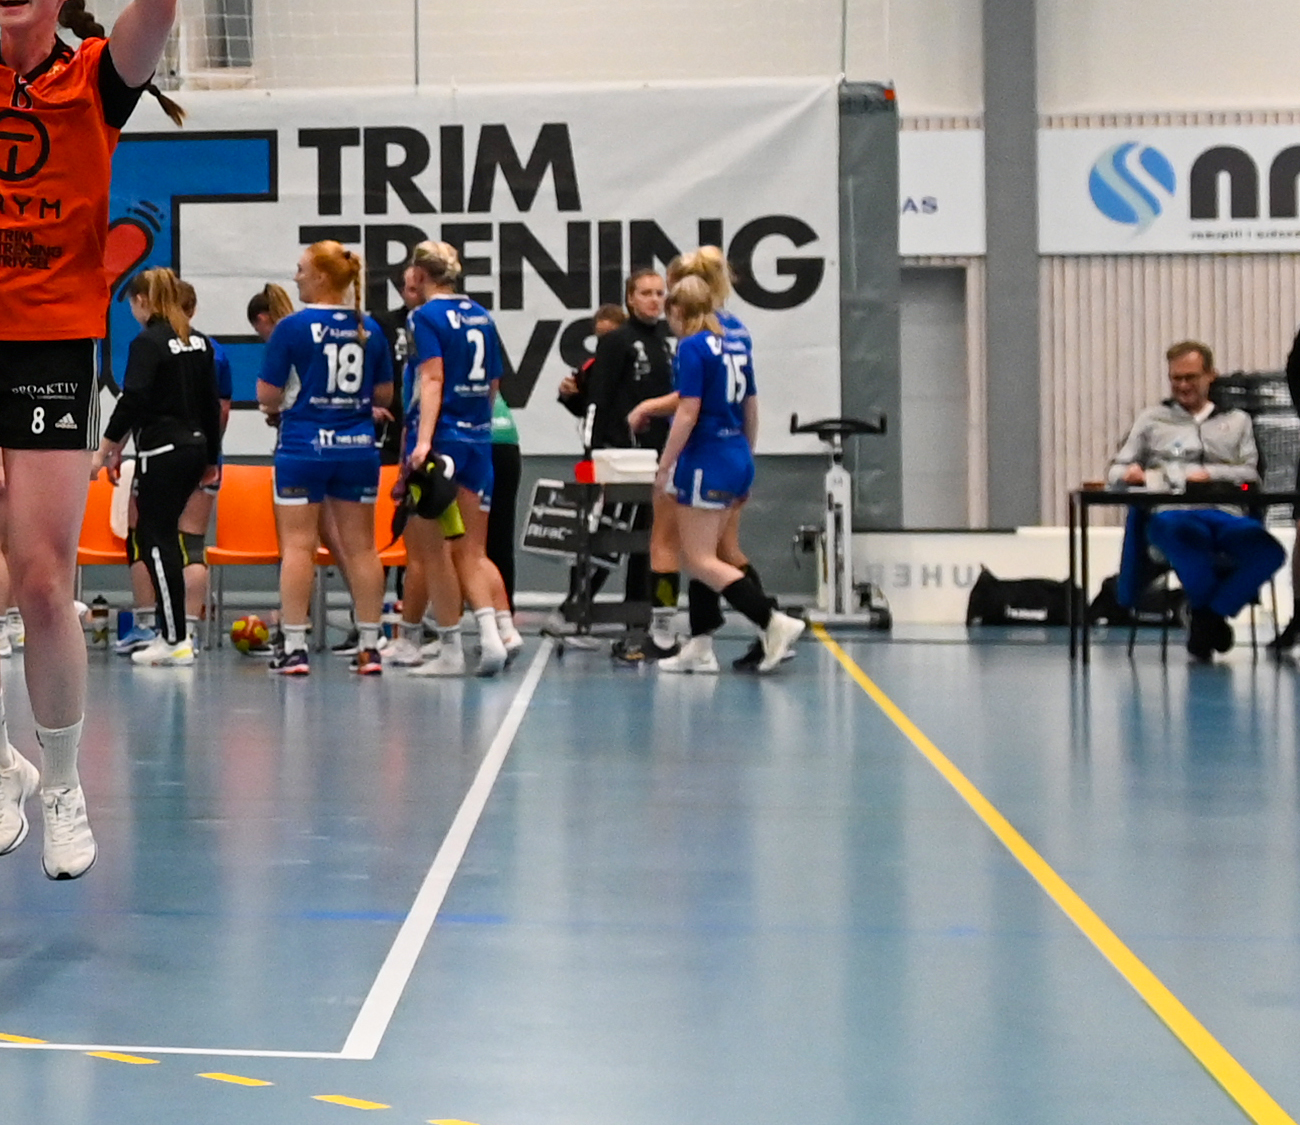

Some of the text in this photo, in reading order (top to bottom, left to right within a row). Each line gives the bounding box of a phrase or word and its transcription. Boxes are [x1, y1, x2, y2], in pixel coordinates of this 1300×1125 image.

[297, 122, 581, 215] TRIM
[323, 343, 365, 394] 18
[466, 328, 486, 381] 2
[722, 353, 748, 404] 15
[11, 382, 79, 399] PROAKTIV
[31, 406, 45, 434] 8
